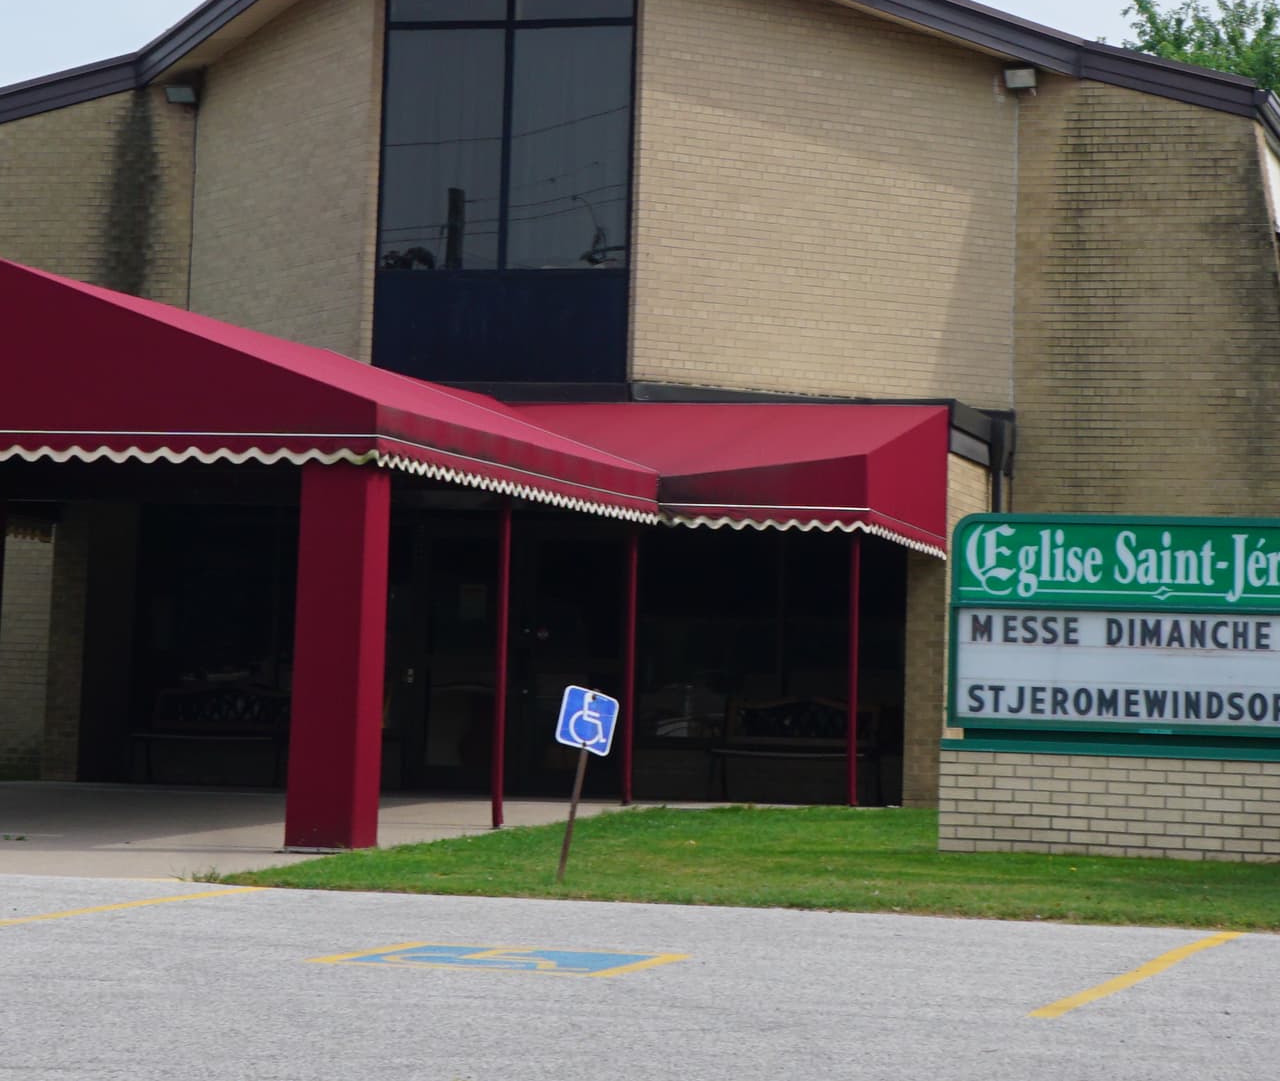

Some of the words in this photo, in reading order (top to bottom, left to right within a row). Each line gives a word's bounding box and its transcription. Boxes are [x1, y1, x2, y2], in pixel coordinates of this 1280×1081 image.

[966, 524, 1103, 597] Eglise
[971, 614, 1080, 645] MESSE
[1106, 619, 1271, 650] DIMANCHE
